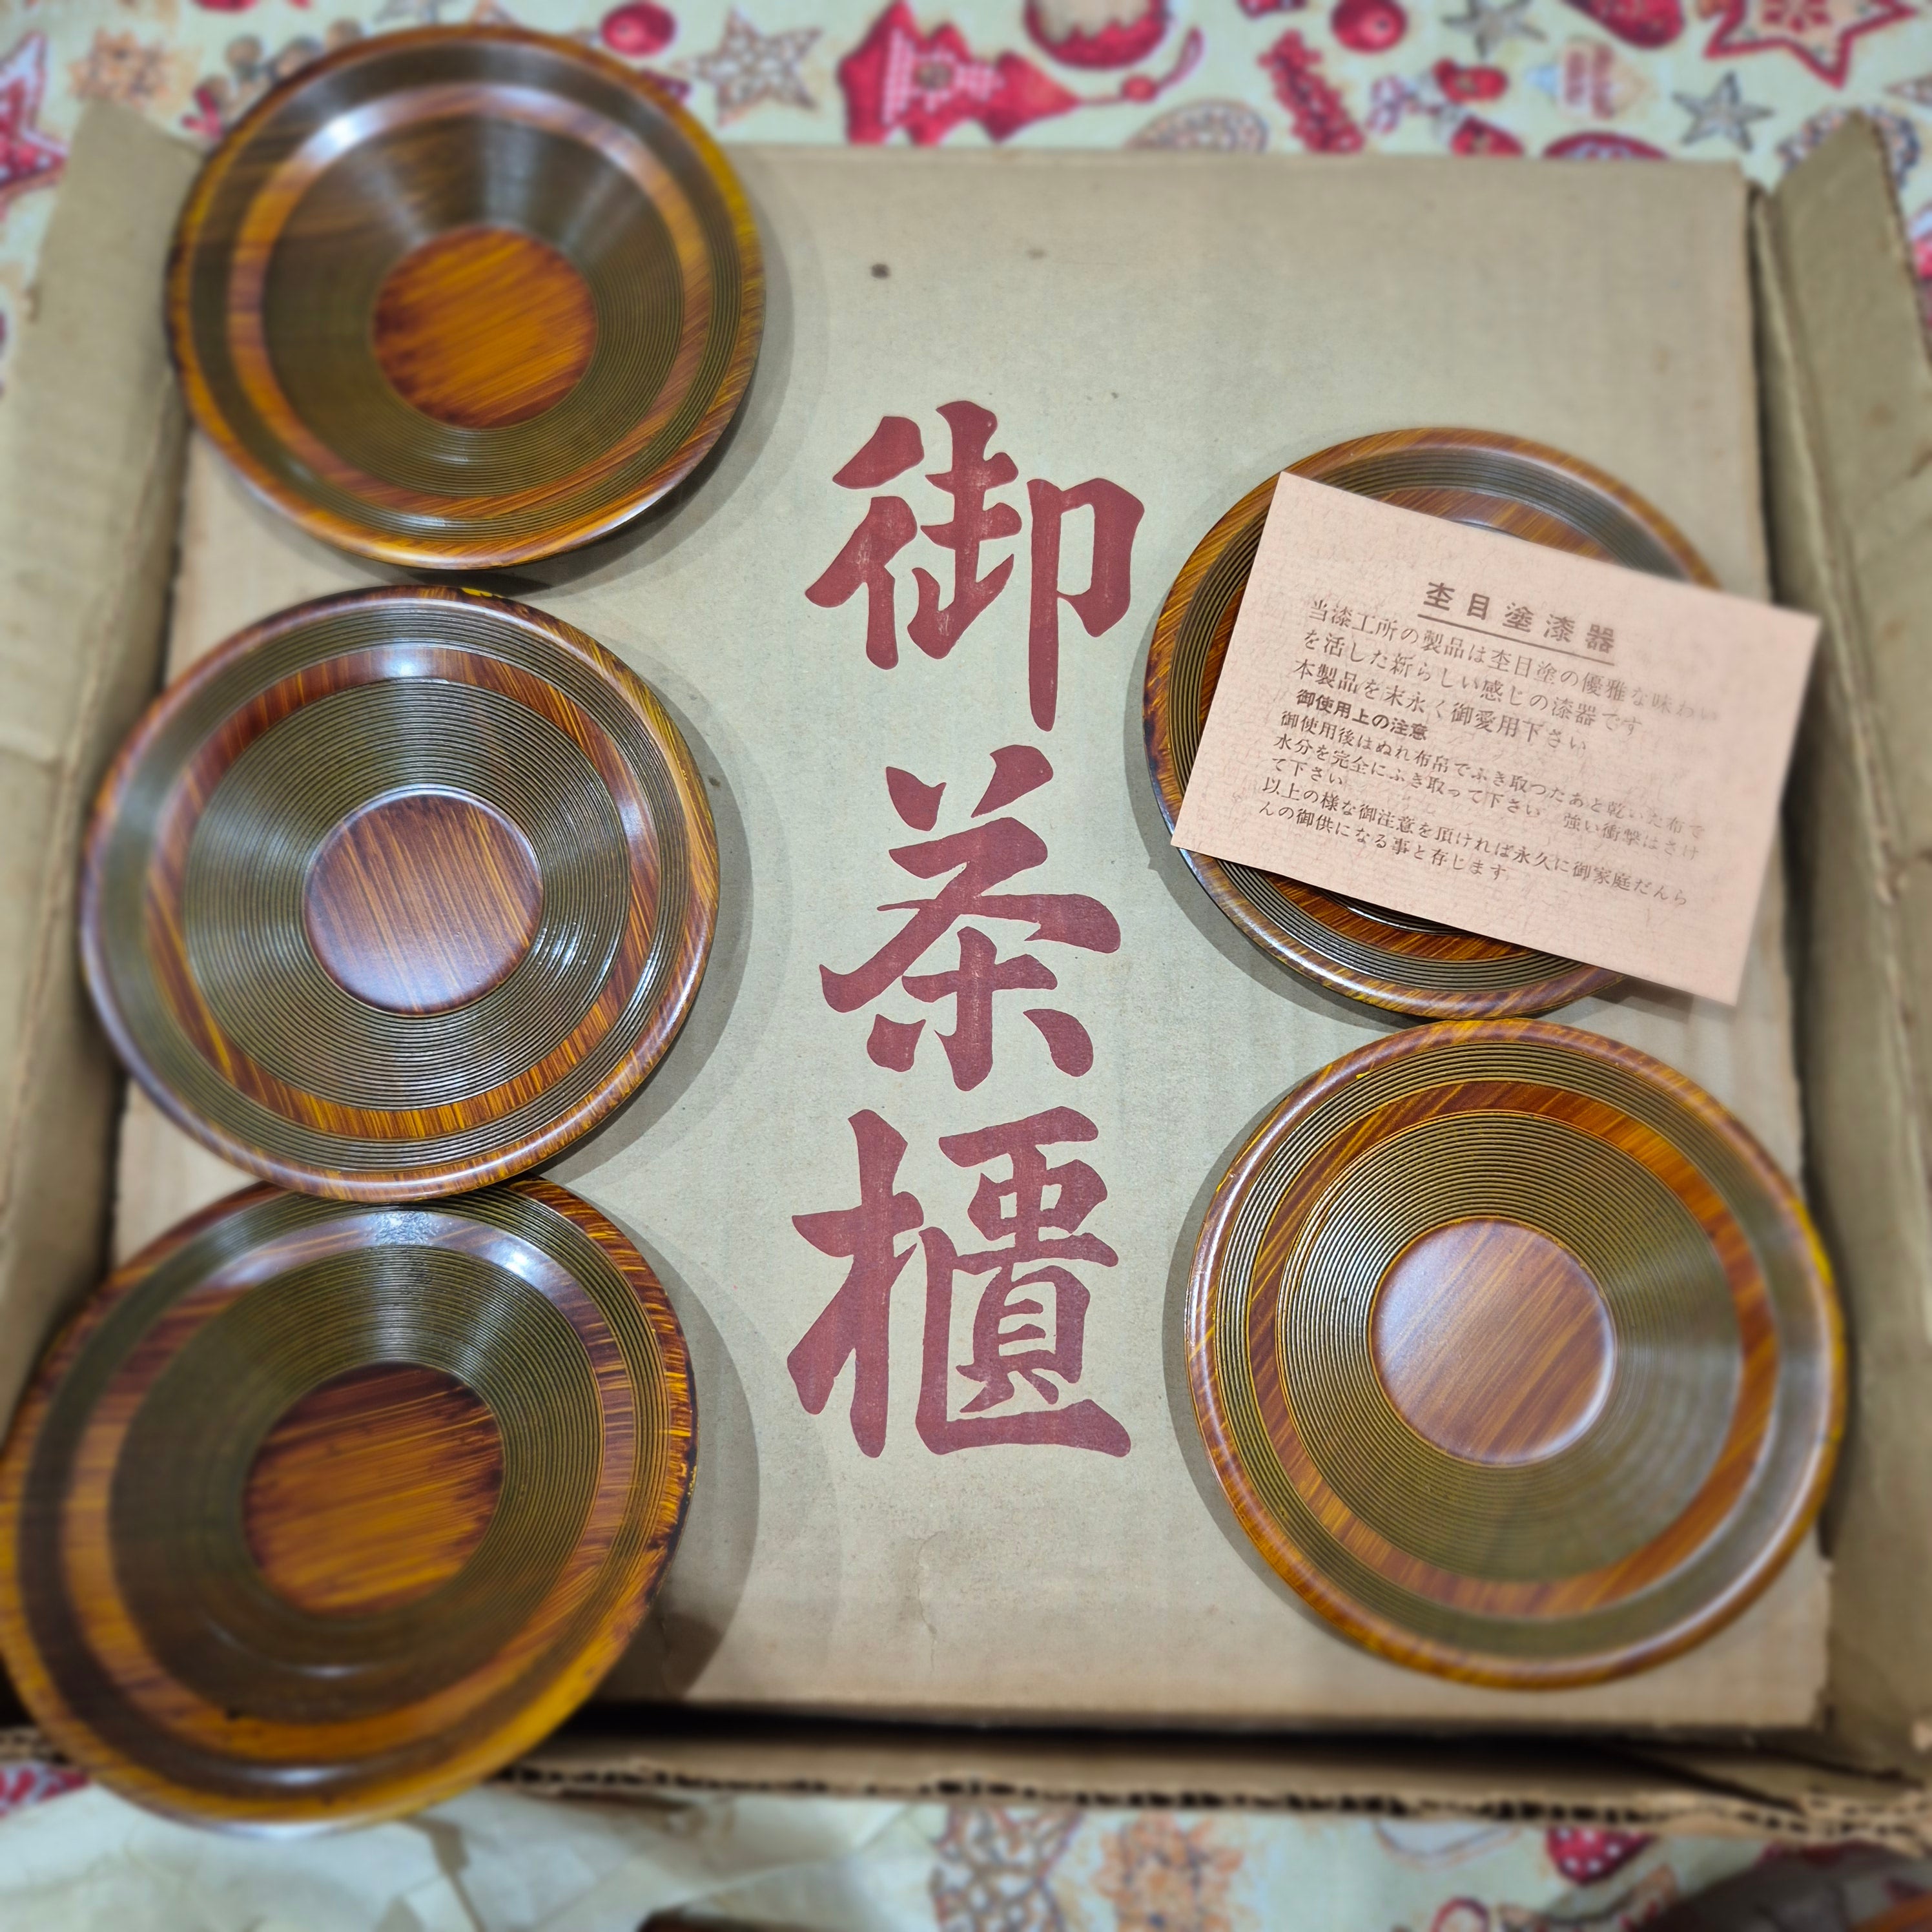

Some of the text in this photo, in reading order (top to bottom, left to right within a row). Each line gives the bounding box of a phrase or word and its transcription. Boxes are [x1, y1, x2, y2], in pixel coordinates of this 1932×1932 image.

[1423, 579, 1618, 655] 杢目塗漆器
[1291, 657, 1587, 750] 本製品を末永く御愛用下さい
[1295, 690, 1428, 741] 御使用上の注意
[1304, 628, 1643, 735] を活した新らしい感じの漆器です
[1269, 756, 1343, 786] て下さい
[1259, 801, 1507, 881] んの御供になる事と存じます
[788, 401, 1145, 1459] 御茶櫃
